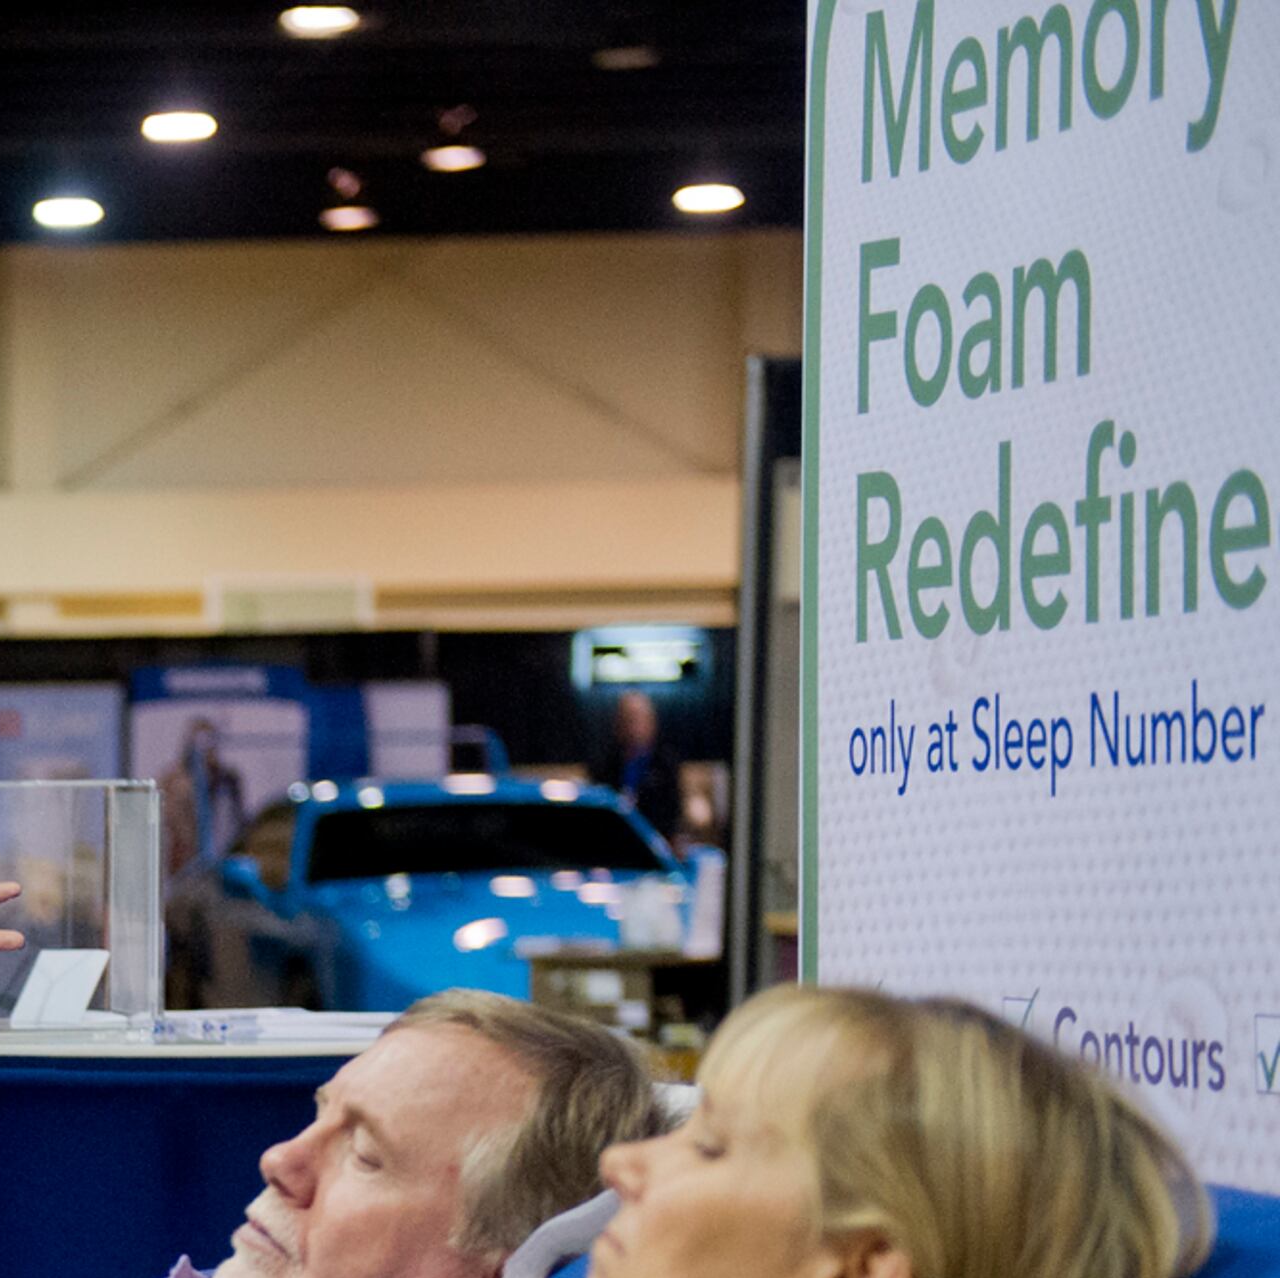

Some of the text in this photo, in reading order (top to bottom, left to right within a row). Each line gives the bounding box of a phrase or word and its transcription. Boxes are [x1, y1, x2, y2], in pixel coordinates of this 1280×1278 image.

[861, 0, 1239, 184] Memory
[857, 236, 1092, 415] Foam
[849, 678, 1265, 797] only at Sleep Number
